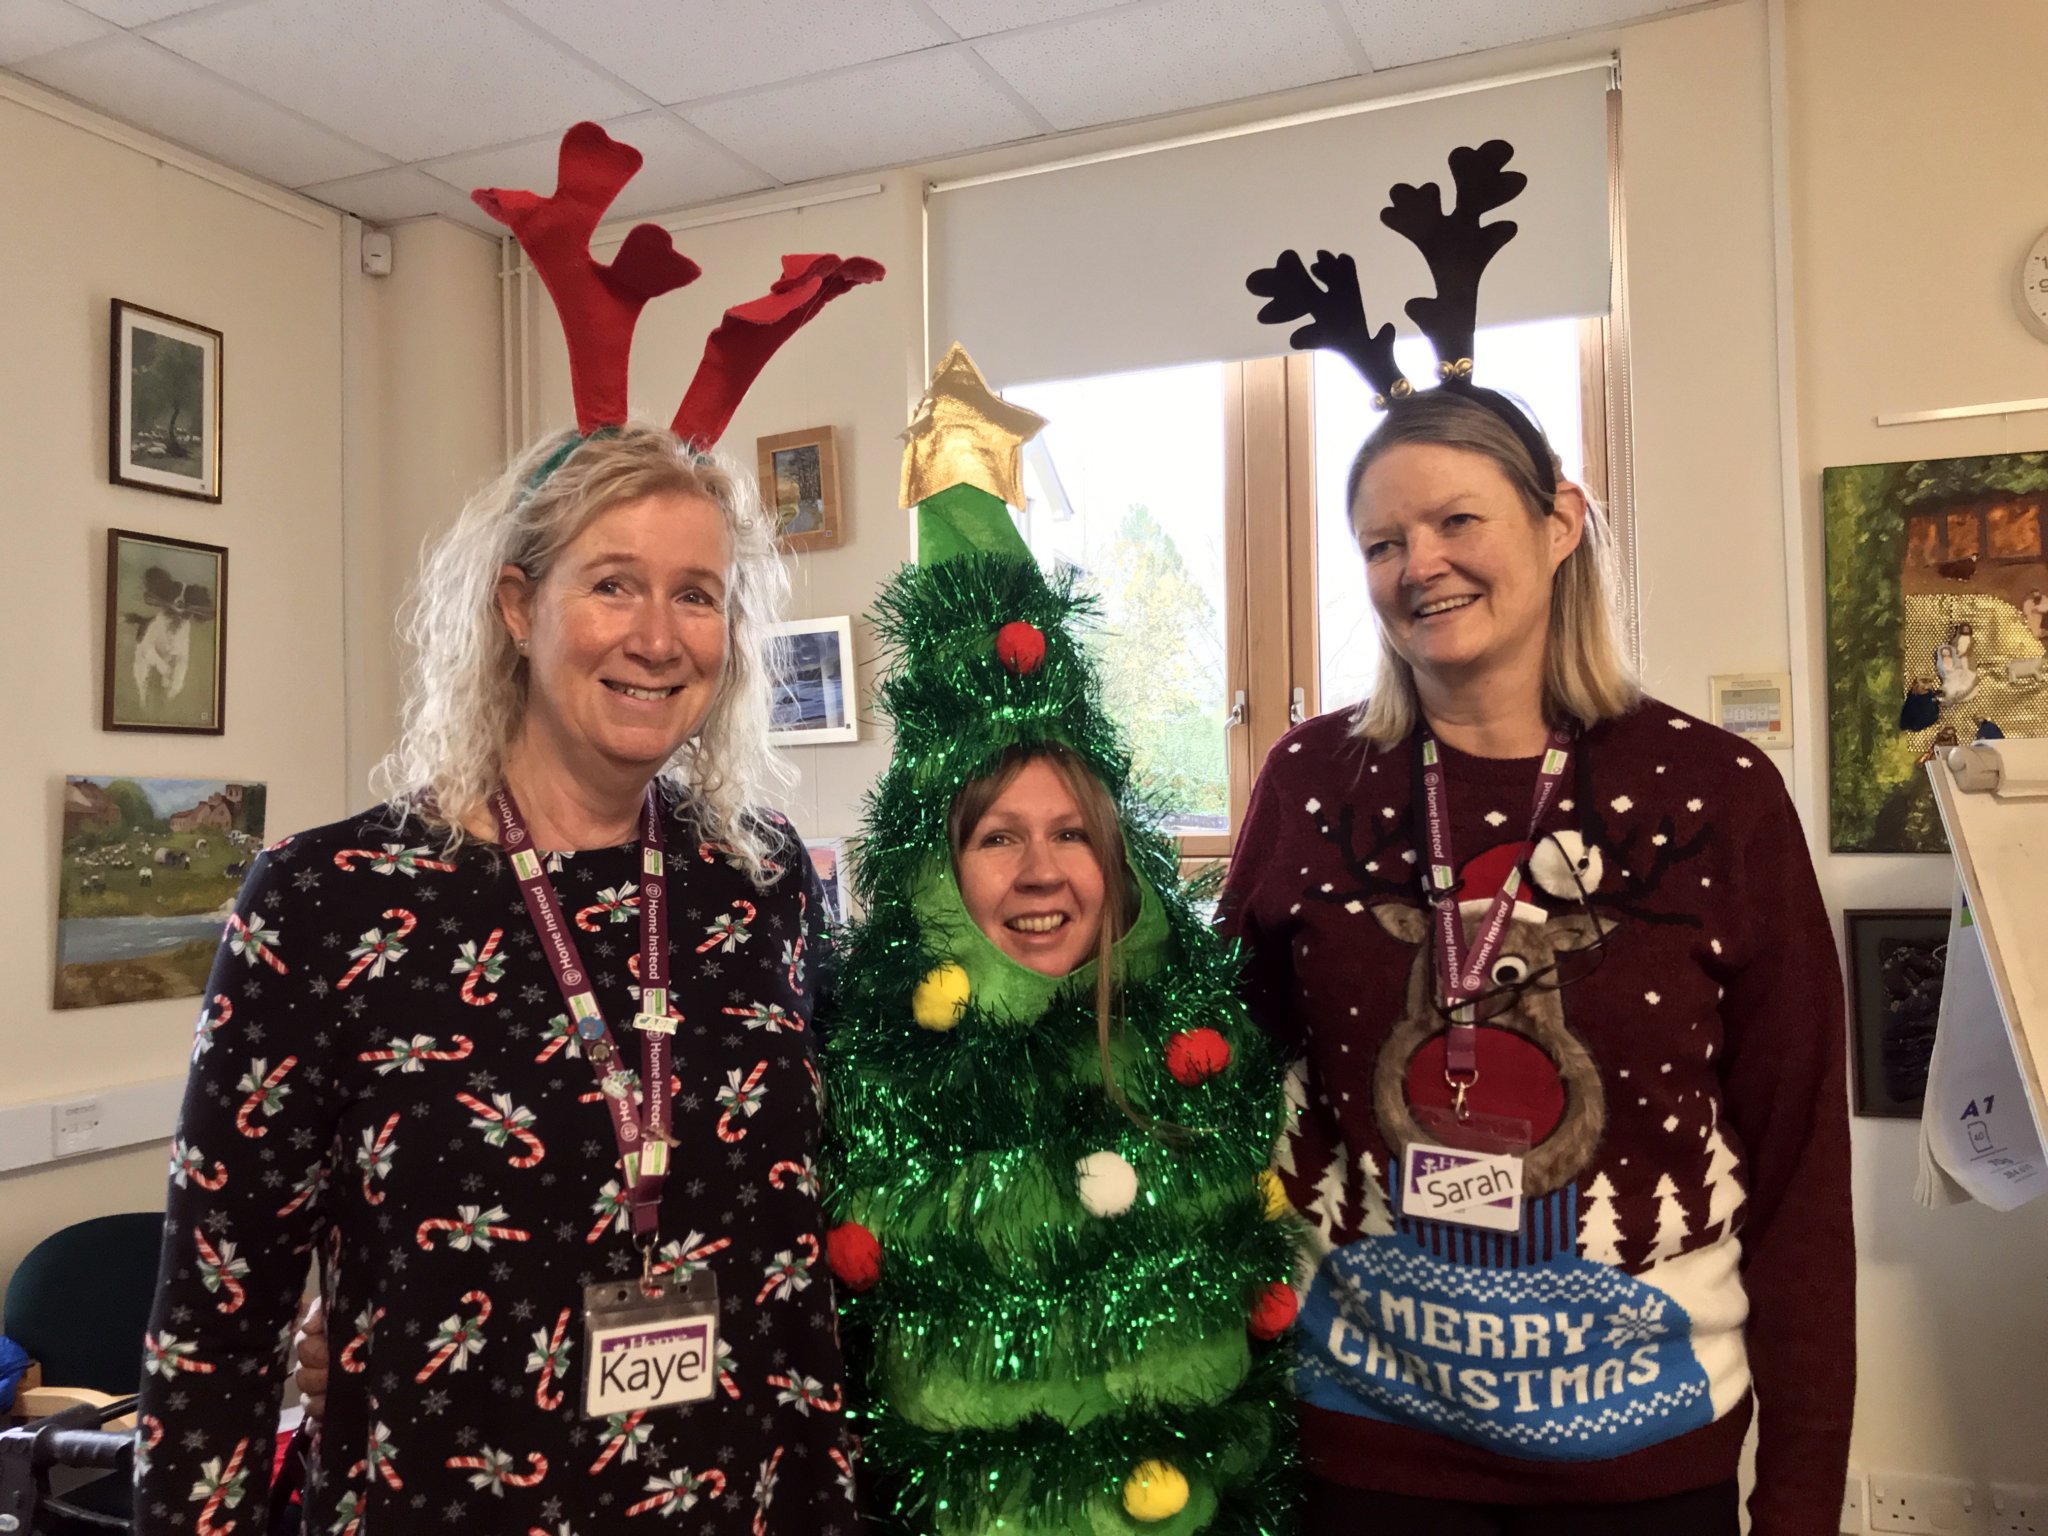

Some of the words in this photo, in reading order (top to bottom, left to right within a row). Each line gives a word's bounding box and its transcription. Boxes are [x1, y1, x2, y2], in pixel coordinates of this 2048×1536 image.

[1427, 787, 1438, 818] Home
[1431, 819, 1445, 858] Instead
[531, 886, 558, 932] Instead
[648, 900, 659, 934] Home
[1443, 912, 1454, 944] Home
[551, 932, 573, 969] Home
[649, 937, 660, 980] Instead
[1471, 942, 1493, 975] Home
[1484, 901, 1509, 943] Instead
[651, 1042, 662, 1079] Home
[1960, 1095, 1995, 1120] A1
[1427, 1165, 1513, 1208] Sarah
[1379, 1289, 1595, 1359] MERRY
[600, 1350, 700, 1400] Kaye
[1327, 1317, 1661, 1413] CHRISTMAS
